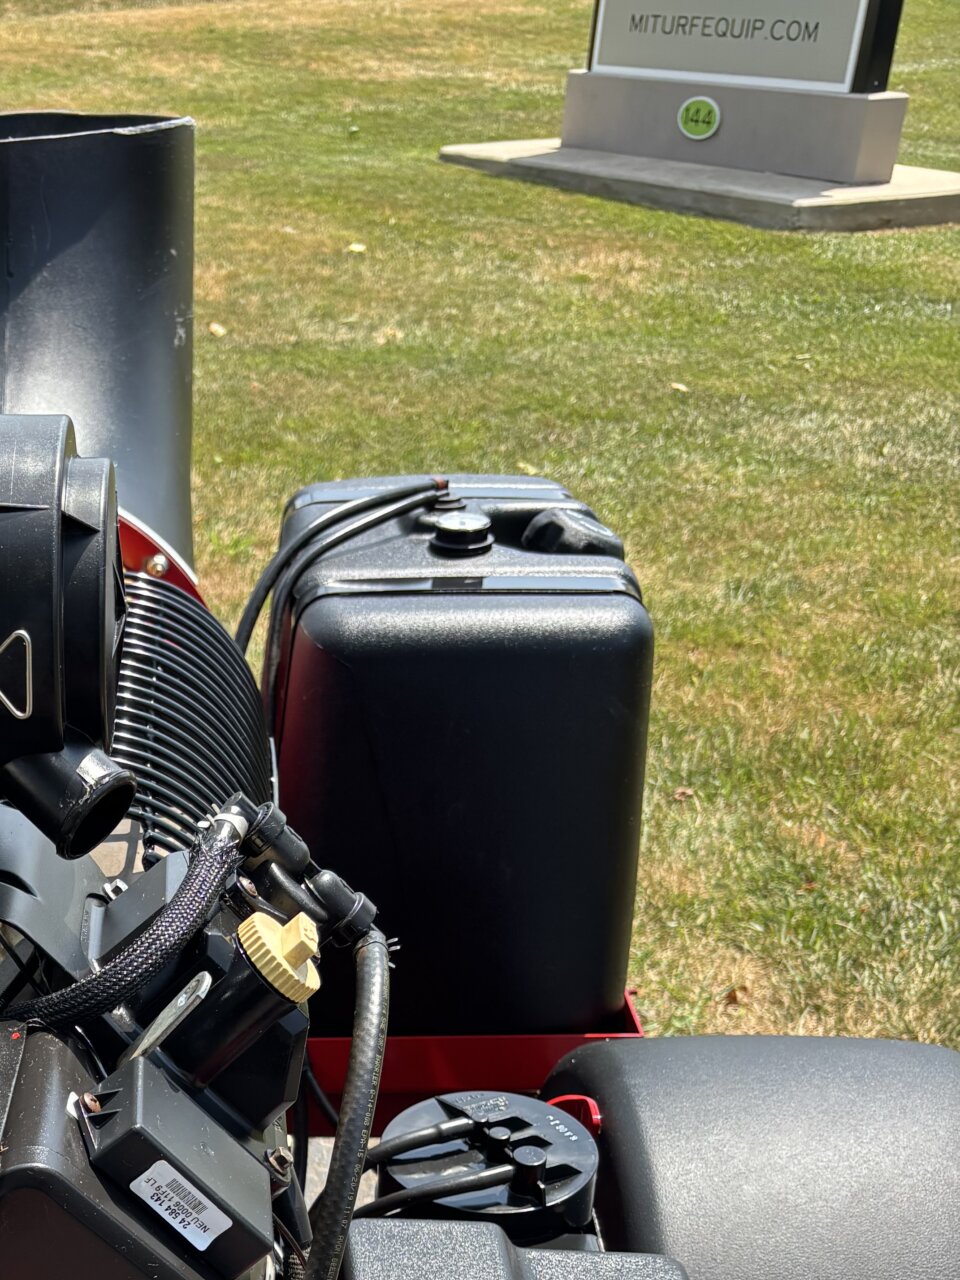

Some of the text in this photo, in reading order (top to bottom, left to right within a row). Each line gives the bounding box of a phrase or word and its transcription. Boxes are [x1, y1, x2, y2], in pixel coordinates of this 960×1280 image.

[629, 14, 819, 43] MITURFEQUIP.COM
[684, 107, 713, 126] 144
[372, 1054, 382, 1086] BARRIER
[144, 1177, 210, 1234] NEU 0006 11F9 LF
[150, 1192, 191, 1229] 24 584 143
